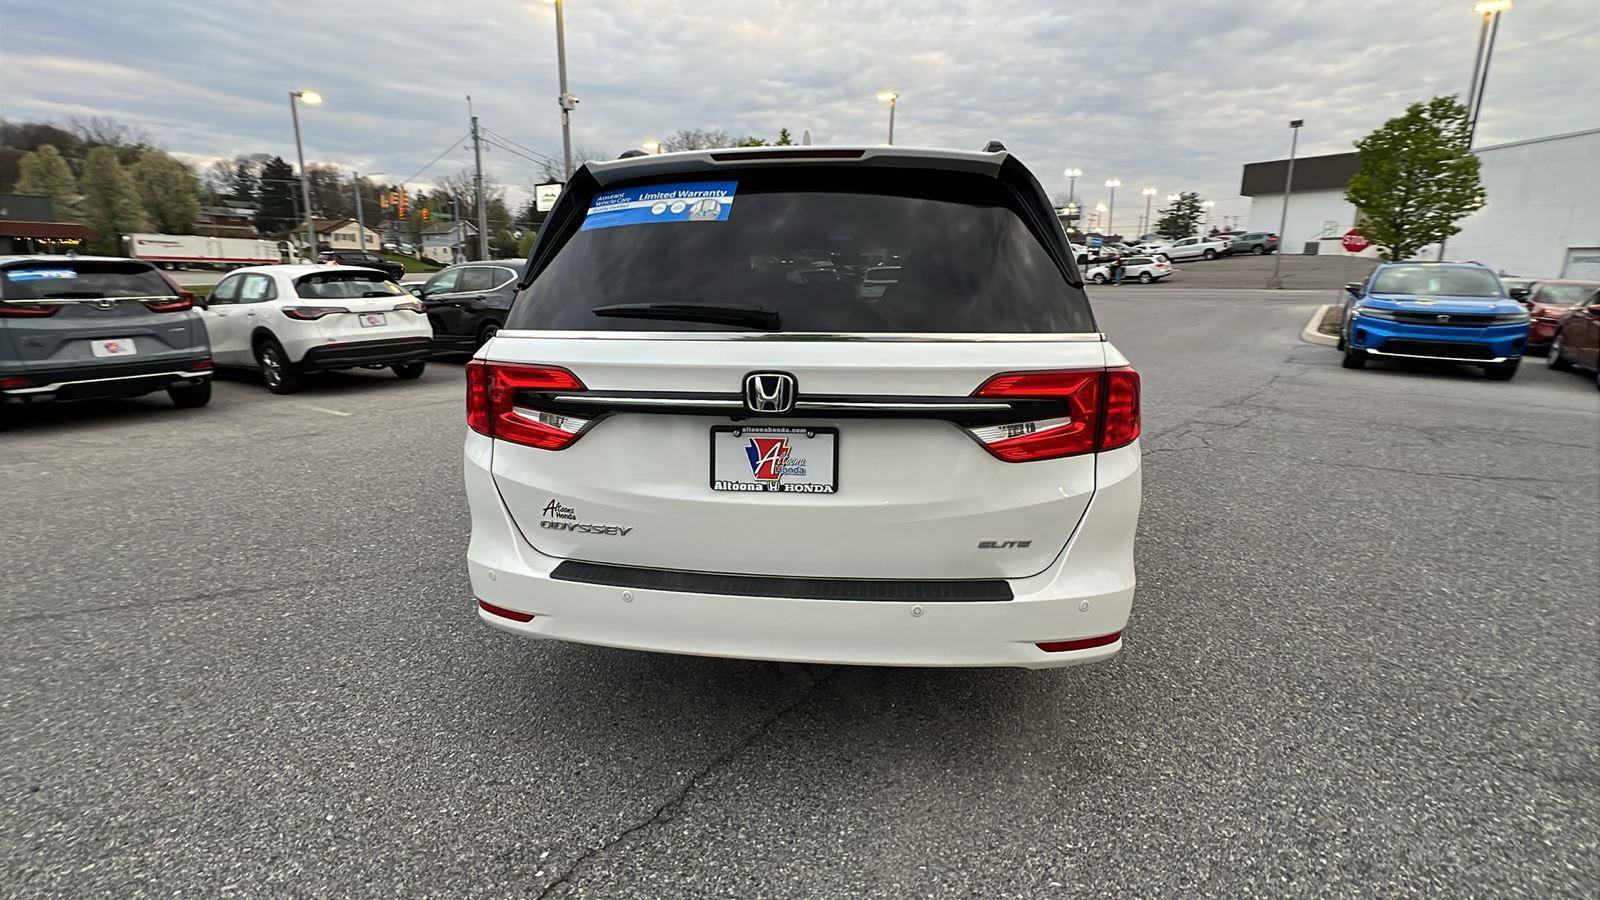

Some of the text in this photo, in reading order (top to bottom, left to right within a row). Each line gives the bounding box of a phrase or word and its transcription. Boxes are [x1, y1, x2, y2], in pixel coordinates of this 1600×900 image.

[638, 189, 728, 201] Limited Warranty
[775, 466, 805, 474] Honda
[714, 481, 763, 491] Altoona
[784, 484, 833, 493] HONDA
[556, 511, 576, 520] Honda
[540, 520, 633, 536] ODYSSEY
[978, 540, 1032, 548] ELITE
